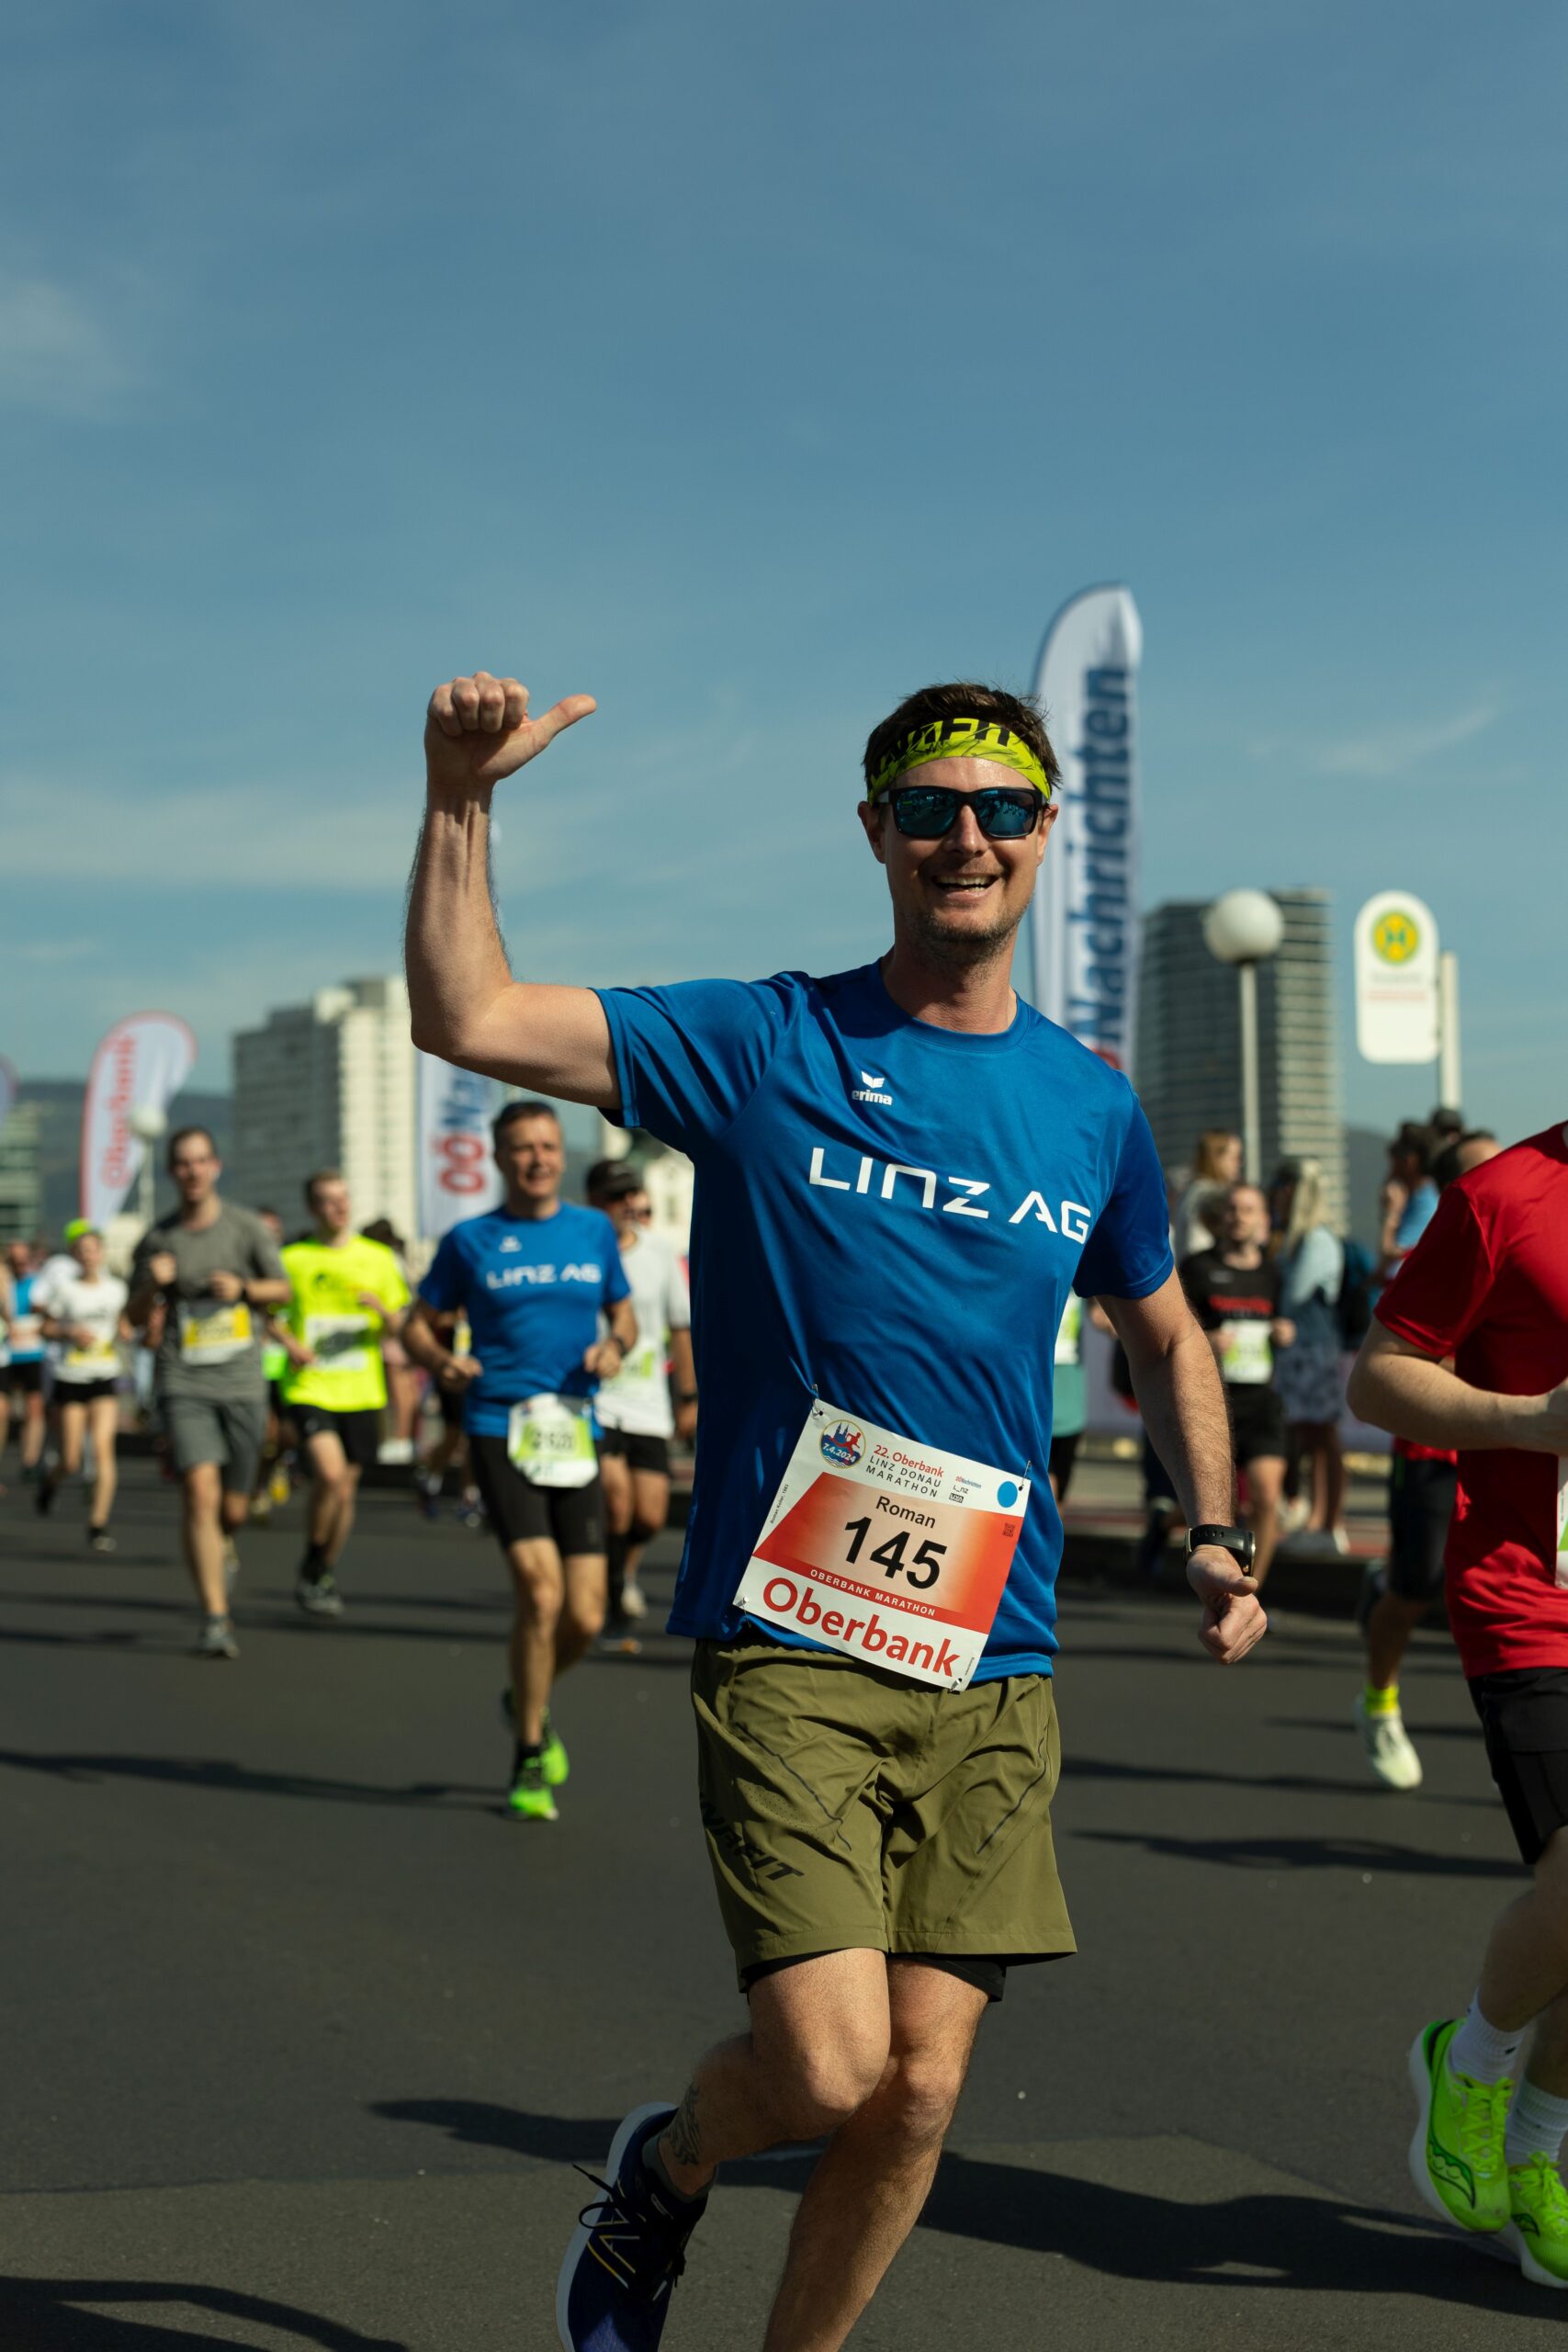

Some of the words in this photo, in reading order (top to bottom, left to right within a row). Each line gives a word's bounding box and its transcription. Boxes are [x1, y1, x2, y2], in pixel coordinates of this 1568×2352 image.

[852, 1089, 893, 1106] erima
[809, 1147, 990, 1219] LINZ
[1009, 1190, 1091, 1245] AG
[823, 1442, 856, 1463] 7.4.2024
[874, 1444, 889, 1459] 22.
[892, 1452, 944, 1477] Oberbank
[866, 1464, 938, 1498] MARATHON
[870, 1455, 896, 1472] LINZ
[900, 1467, 942, 1487] DONAU
[875, 1496, 936, 1529] Roman
[844, 1516, 947, 1589] 145
[810, 1569, 871, 1598] OBERBANK
[874, 1592, 936, 1616] MARATHON
[763, 1577, 960, 1678] Oberbank
